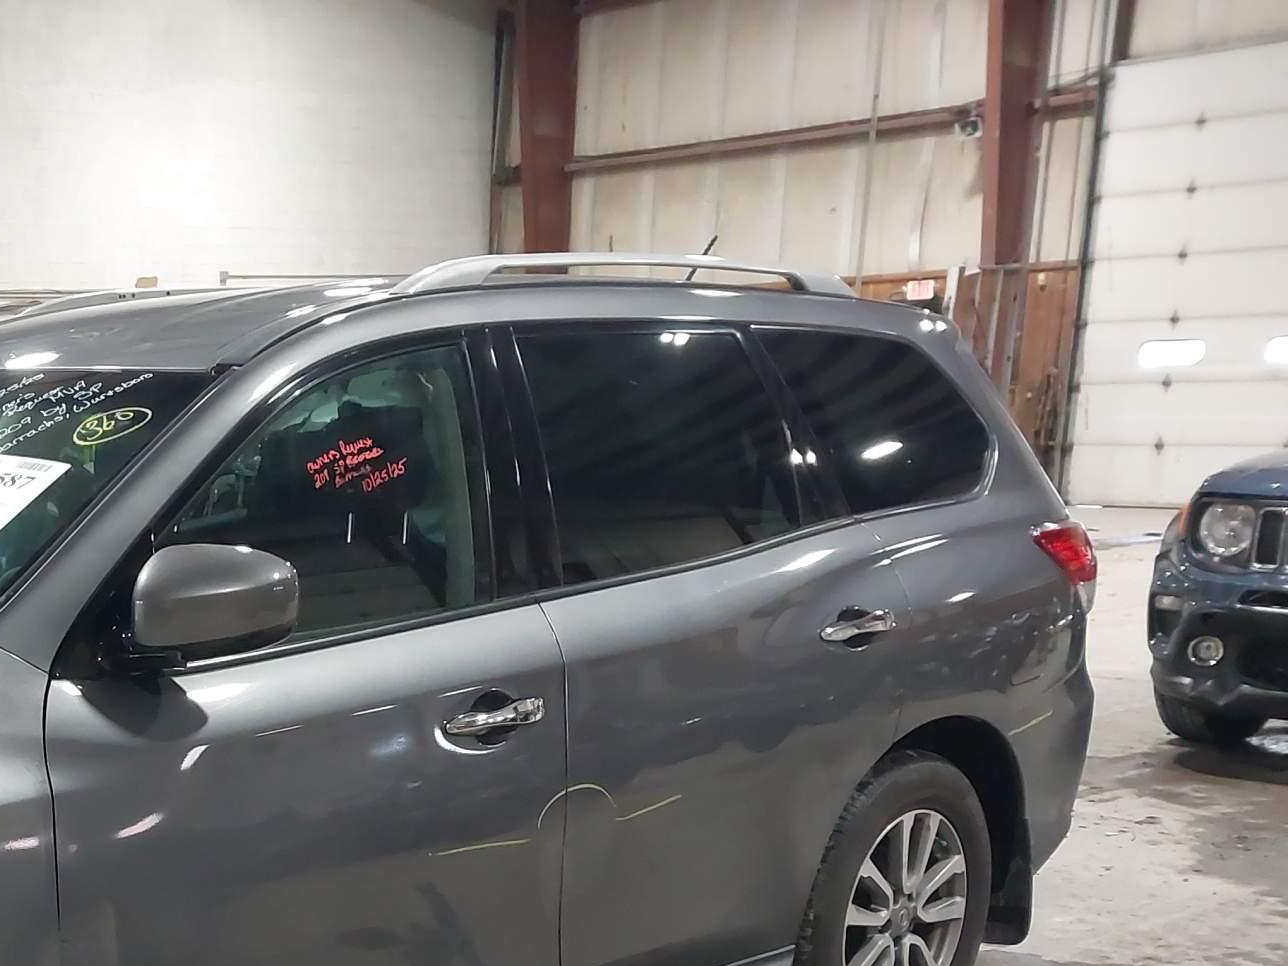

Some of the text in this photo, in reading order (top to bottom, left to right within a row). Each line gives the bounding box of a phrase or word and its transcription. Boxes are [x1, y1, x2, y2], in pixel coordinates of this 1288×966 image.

[39, 402, 67, 418] by
[78, 410, 135, 441] 360
[361, 456, 408, 493] 10/25/25
